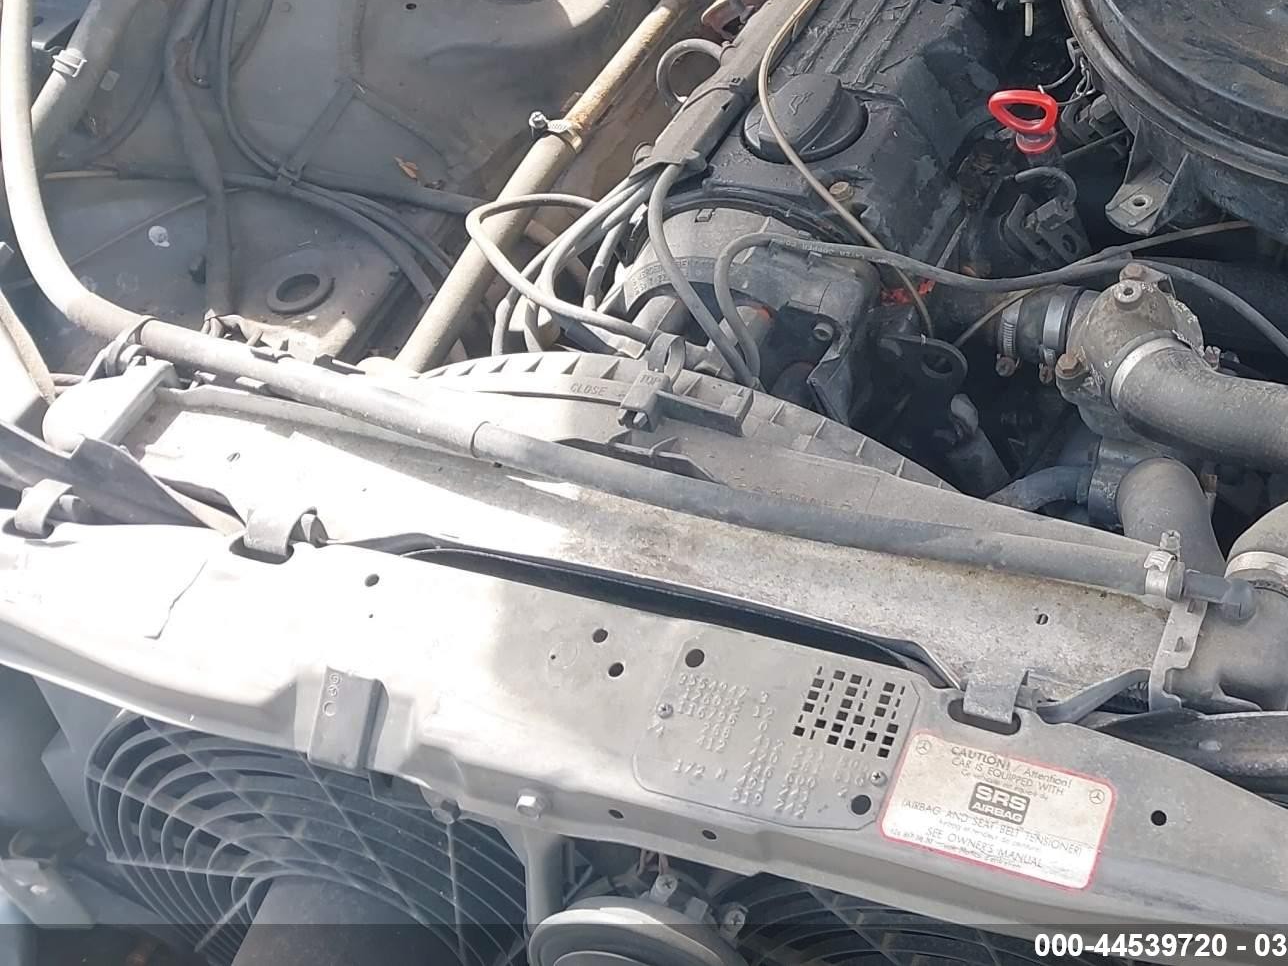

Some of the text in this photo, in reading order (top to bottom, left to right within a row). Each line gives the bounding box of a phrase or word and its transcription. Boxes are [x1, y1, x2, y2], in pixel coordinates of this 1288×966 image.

[570, 382, 608, 397] CLOSE
[639, 374, 662, 386] TOP
[950, 745, 1011, 771] CAUTION!
[1023, 767, 1072, 789] Attention!
[951, 757, 972, 770] CAR
[974, 762, 984, 772] IS
[988, 766, 1033, 787] EQUIPPED
[1038, 781, 1065, 795] WITH
[975, 785, 1028, 811] SRS
[945, 810, 968, 823] AND
[973, 816, 994, 830] SEAT
[1000, 823, 1021, 836] BELT
[971, 802, 1023, 823] AIRBAG
[926, 827, 944, 841] SEE
[998, 844, 1043, 868] MANUAL
